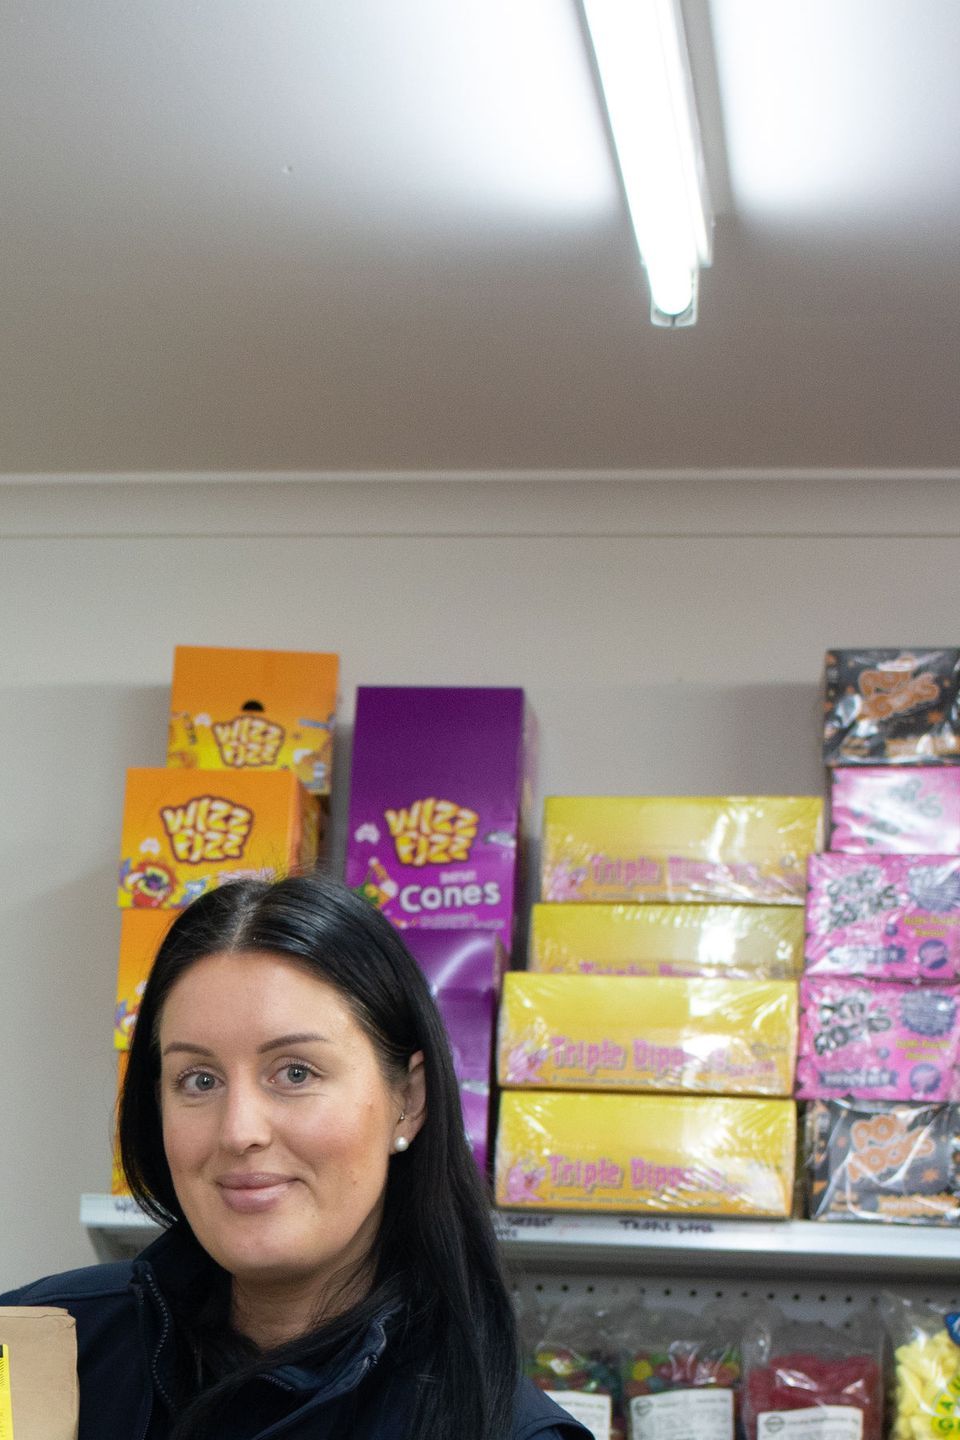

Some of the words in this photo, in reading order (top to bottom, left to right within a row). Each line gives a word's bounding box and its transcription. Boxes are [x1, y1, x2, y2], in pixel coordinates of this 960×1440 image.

[214, 717, 284, 746] WIZZ
[222, 740, 280, 767] FIZZ
[163, 797, 252, 836] WIZZ
[386, 799, 478, 838] WIZZ
[172, 830, 245, 864] FIZZ
[395, 832, 472, 866] FIZZ
[400, 882, 500, 913] Cones
[548, 1155, 623, 1194] Triple
